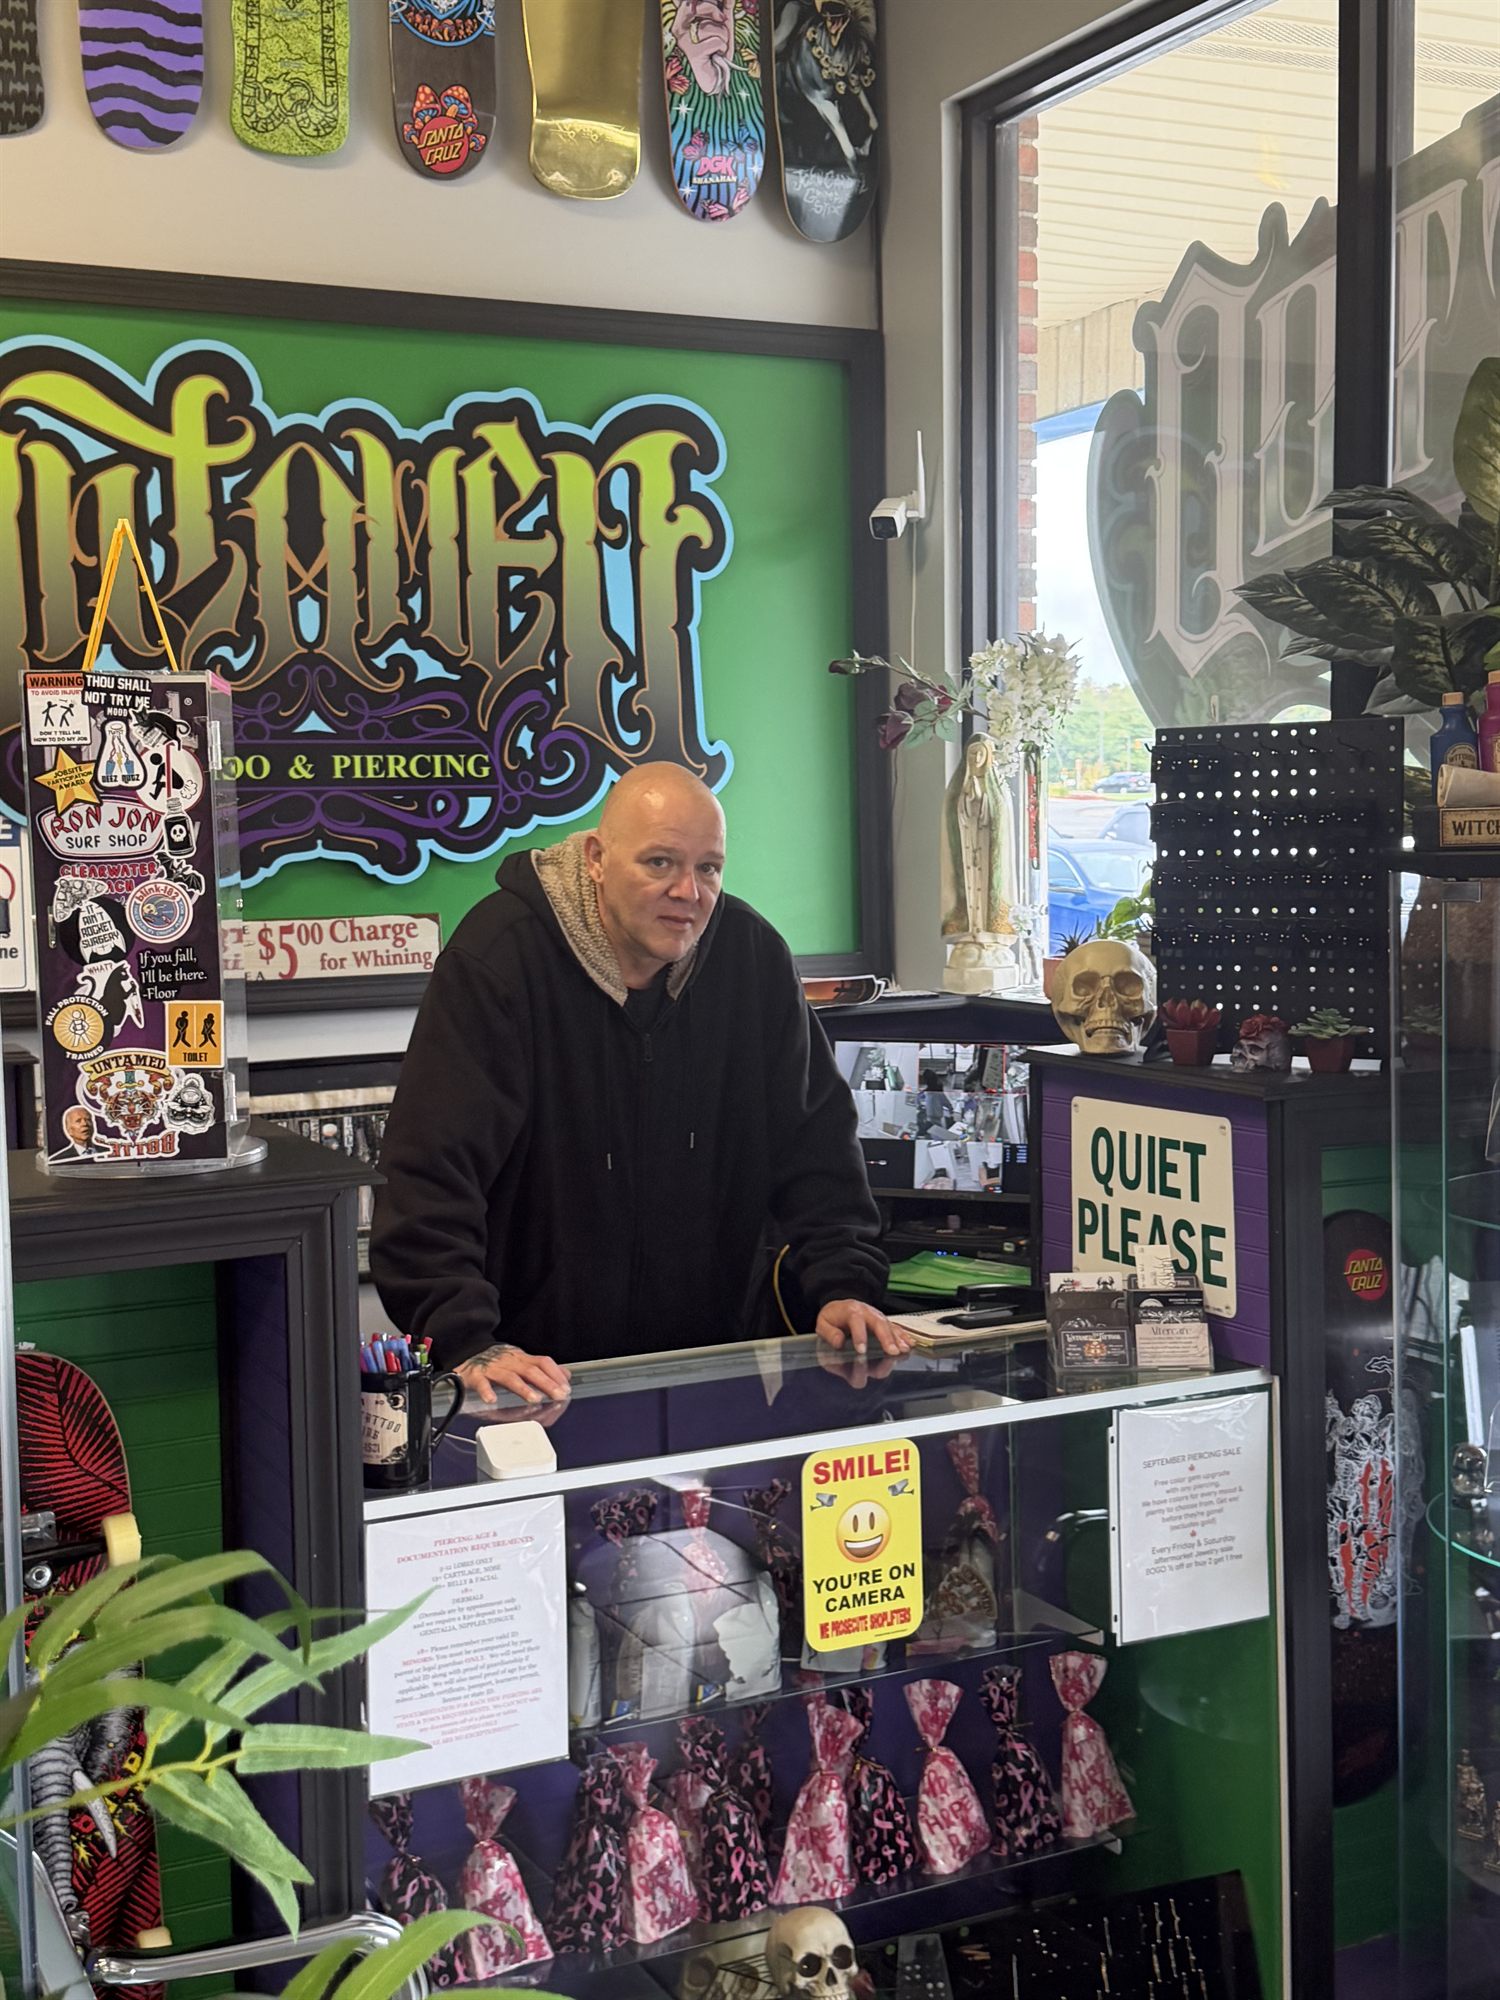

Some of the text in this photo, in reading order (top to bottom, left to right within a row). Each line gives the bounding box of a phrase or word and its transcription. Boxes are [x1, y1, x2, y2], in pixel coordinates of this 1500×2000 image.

[417, 123, 464, 149] SANTA
[425, 142, 463, 166] CRUZ
[697, 156, 736, 176] DGK
[30, 676, 83, 687] WARNING
[86, 675, 152, 692] THOU SHALL
[84, 692, 150, 708] NOT TRY ME
[107, 708, 128, 716] MOOD
[54, 766, 82, 778] JOBSITE
[288, 754, 315, 779] &
[332, 753, 492, 779] PIERCING
[47, 772, 92, 785] PARTICIPATION
[59, 779, 85, 790] AWARD
[51, 806, 161, 839] RON JON
[66, 834, 147, 849] SURF SHOP
[60, 861, 158, 879] CLEARWATER
[135, 885, 179, 902] blink-182
[86, 905, 94, 914] IT
[82, 912, 104, 926] AIN'T
[81, 922, 114, 938] ROCKET
[329, 918, 418, 947] Charge
[82, 932, 120, 948] SURGERY
[139, 948, 196, 968] If you fall,
[320, 948, 433, 971] for Whining
[88, 962, 113, 974] WHAT?
[141, 967, 207, 983] I'll be there.
[143, 986, 178, 1000] -Floor
[45, 996, 109, 1026] FALL PROTECTION
[66, 1045, 104, 1060] TRAINED
[183, 1052, 208, 1062] TOILET
[90, 1054, 166, 1074] UNTAMED
[1090, 1126, 1207, 1202] QUIET
[1078, 1198, 1227, 1289] PLEASE
[1344, 1257, 1382, 1275] SANTA
[1352, 1274, 1383, 1291] CRUZ
[1143, 1446, 1241, 1469] SEPTEMBER PIERCING SALE
[813, 1449, 910, 1485] SMILE!
[1202, 1470, 1230, 1479] upgrade
[434, 1535, 473, 1547] PIERCING
[1152, 1547, 1171, 1555] Every
[1172, 1542, 1195, 1550] Friday
[1204, 1536, 1236, 1545] Saturday
[397, 1536, 535, 1564] DOCUMENTATION REQUIREMENTS
[813, 1562, 916, 1594] YOU'RE ON
[825, 1585, 905, 1613] CAMERA
[820, 1622, 829, 1639] WE
[831, 1615, 868, 1637] PROSECUTE
[870, 1607, 911, 1630] SHOPLIFTERS
